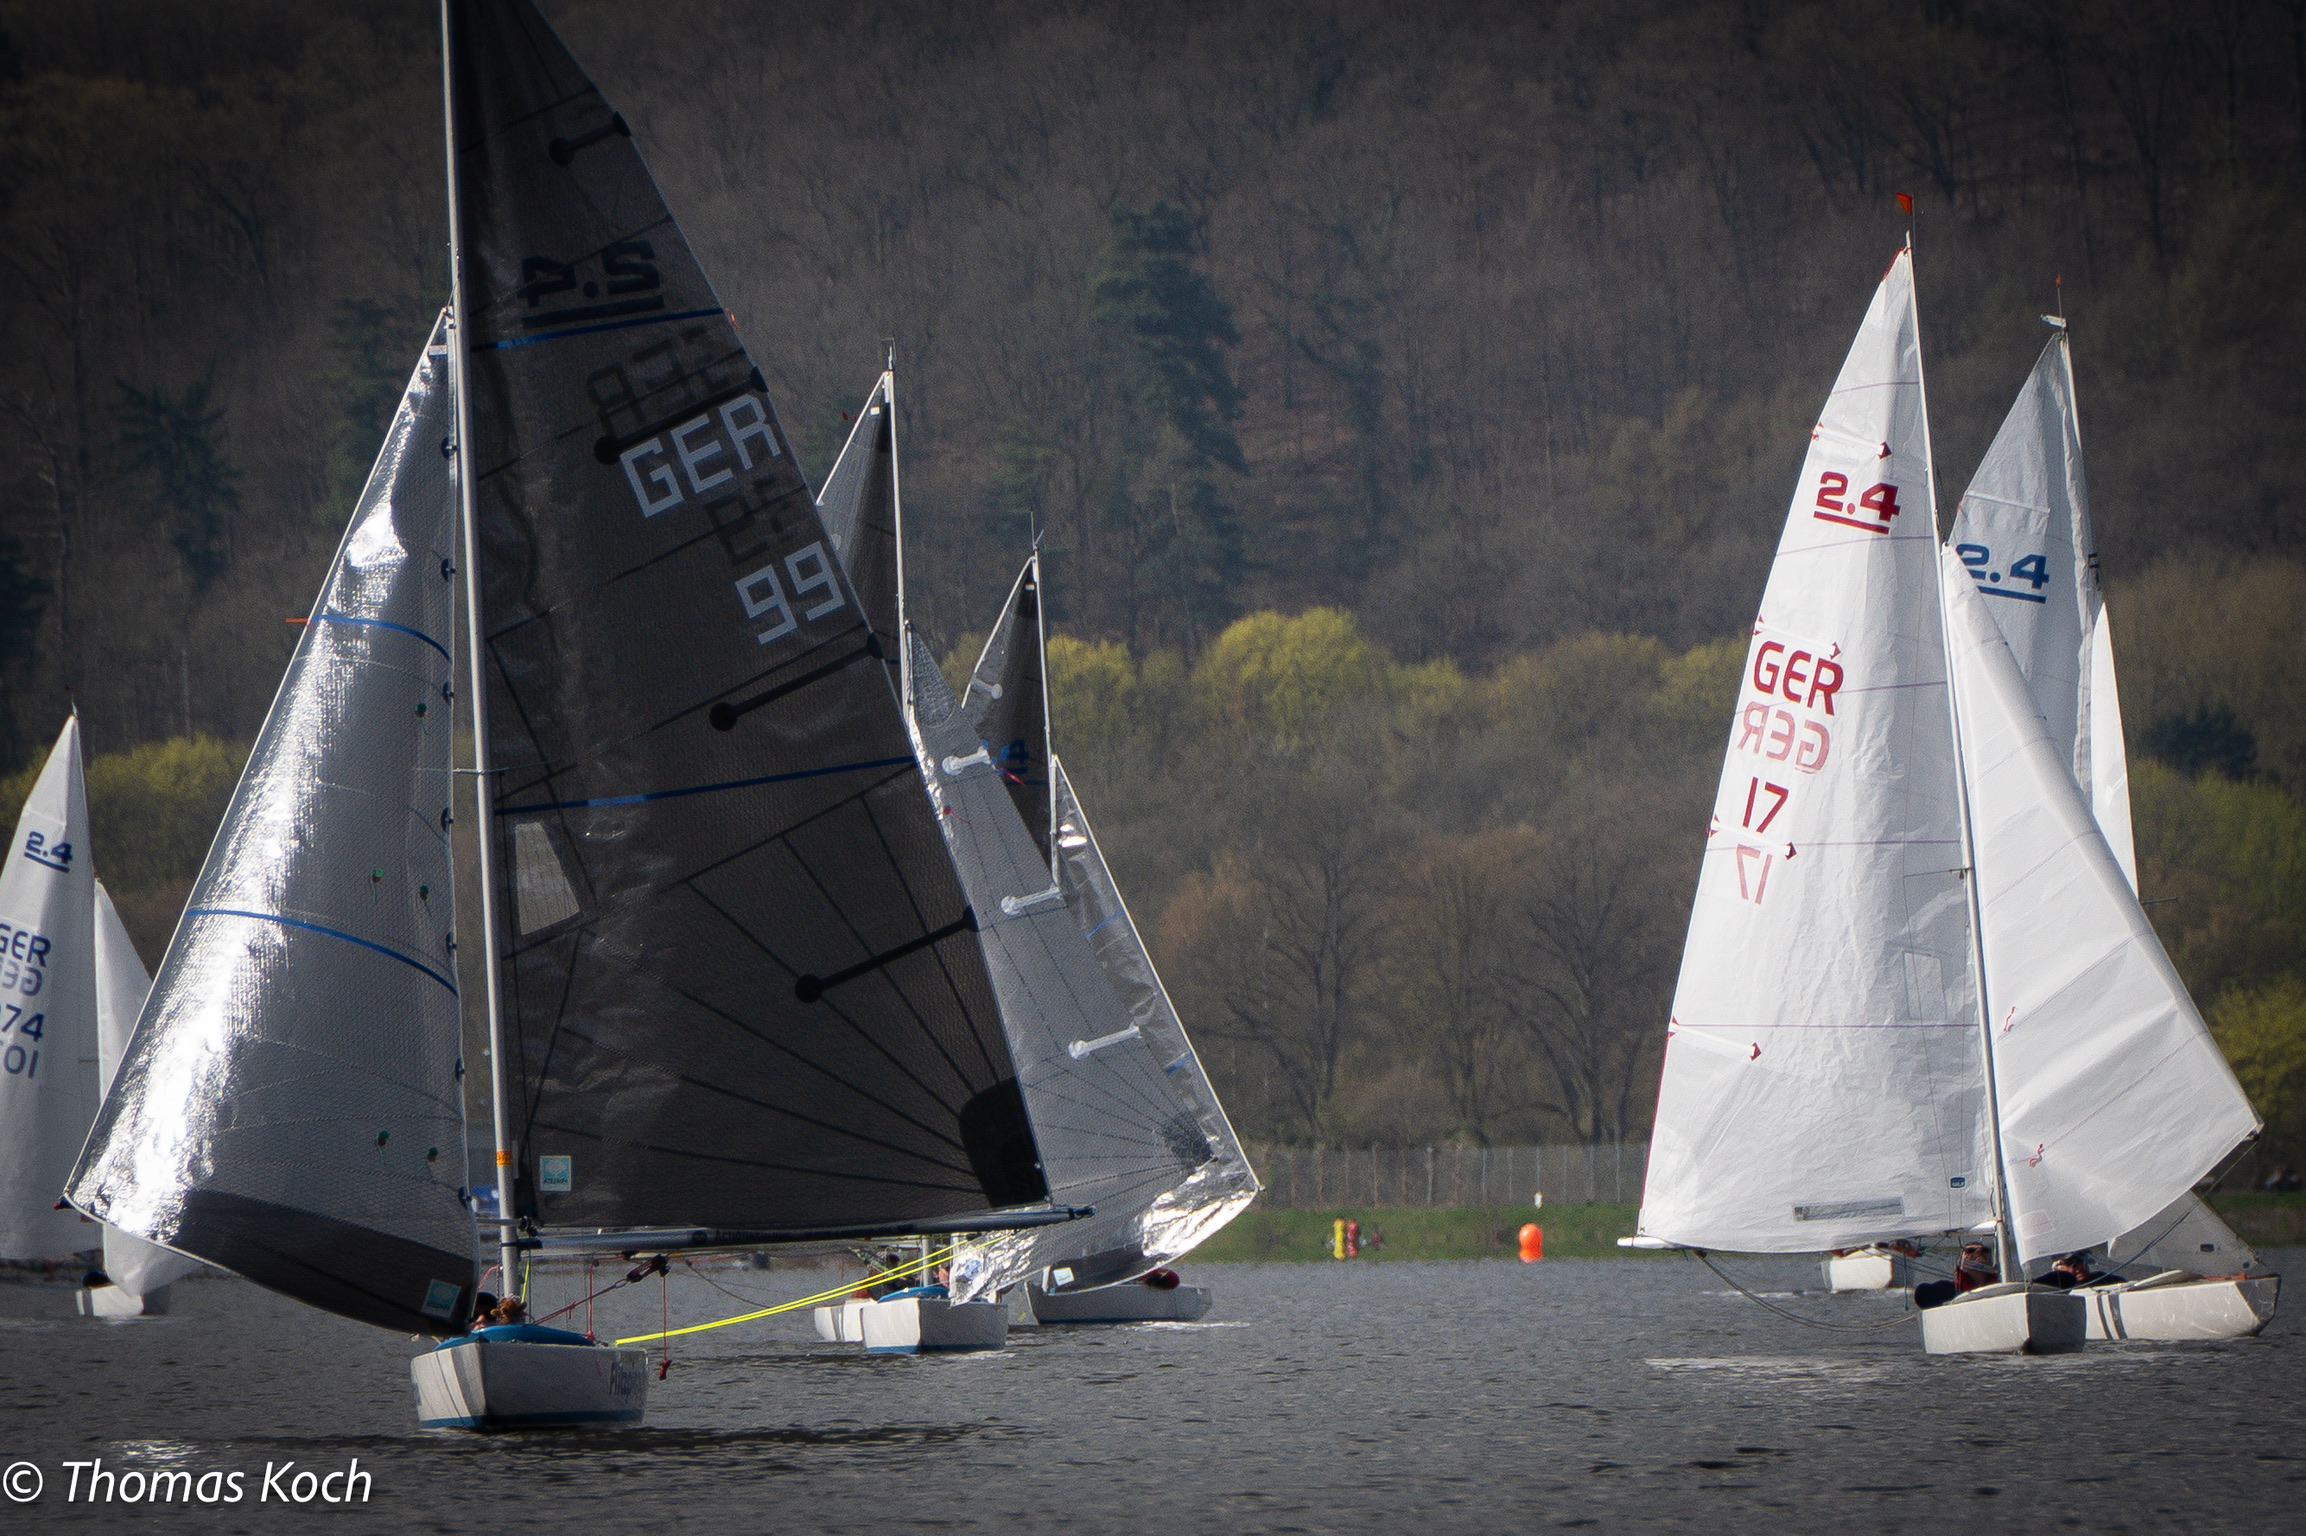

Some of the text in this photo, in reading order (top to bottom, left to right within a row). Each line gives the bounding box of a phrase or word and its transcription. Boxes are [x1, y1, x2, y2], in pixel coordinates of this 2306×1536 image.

[620, 394, 782, 518] GER
[1816, 471, 1901, 522] 2.4
[735, 541, 846, 645] 99
[1955, 543, 2050, 590] 2.4
[1753, 640, 1844, 716] GER
[1742, 776, 1789, 833] 17
[25, 831, 73, 865] 2.4
[0, 1003, 45, 1043] 74
